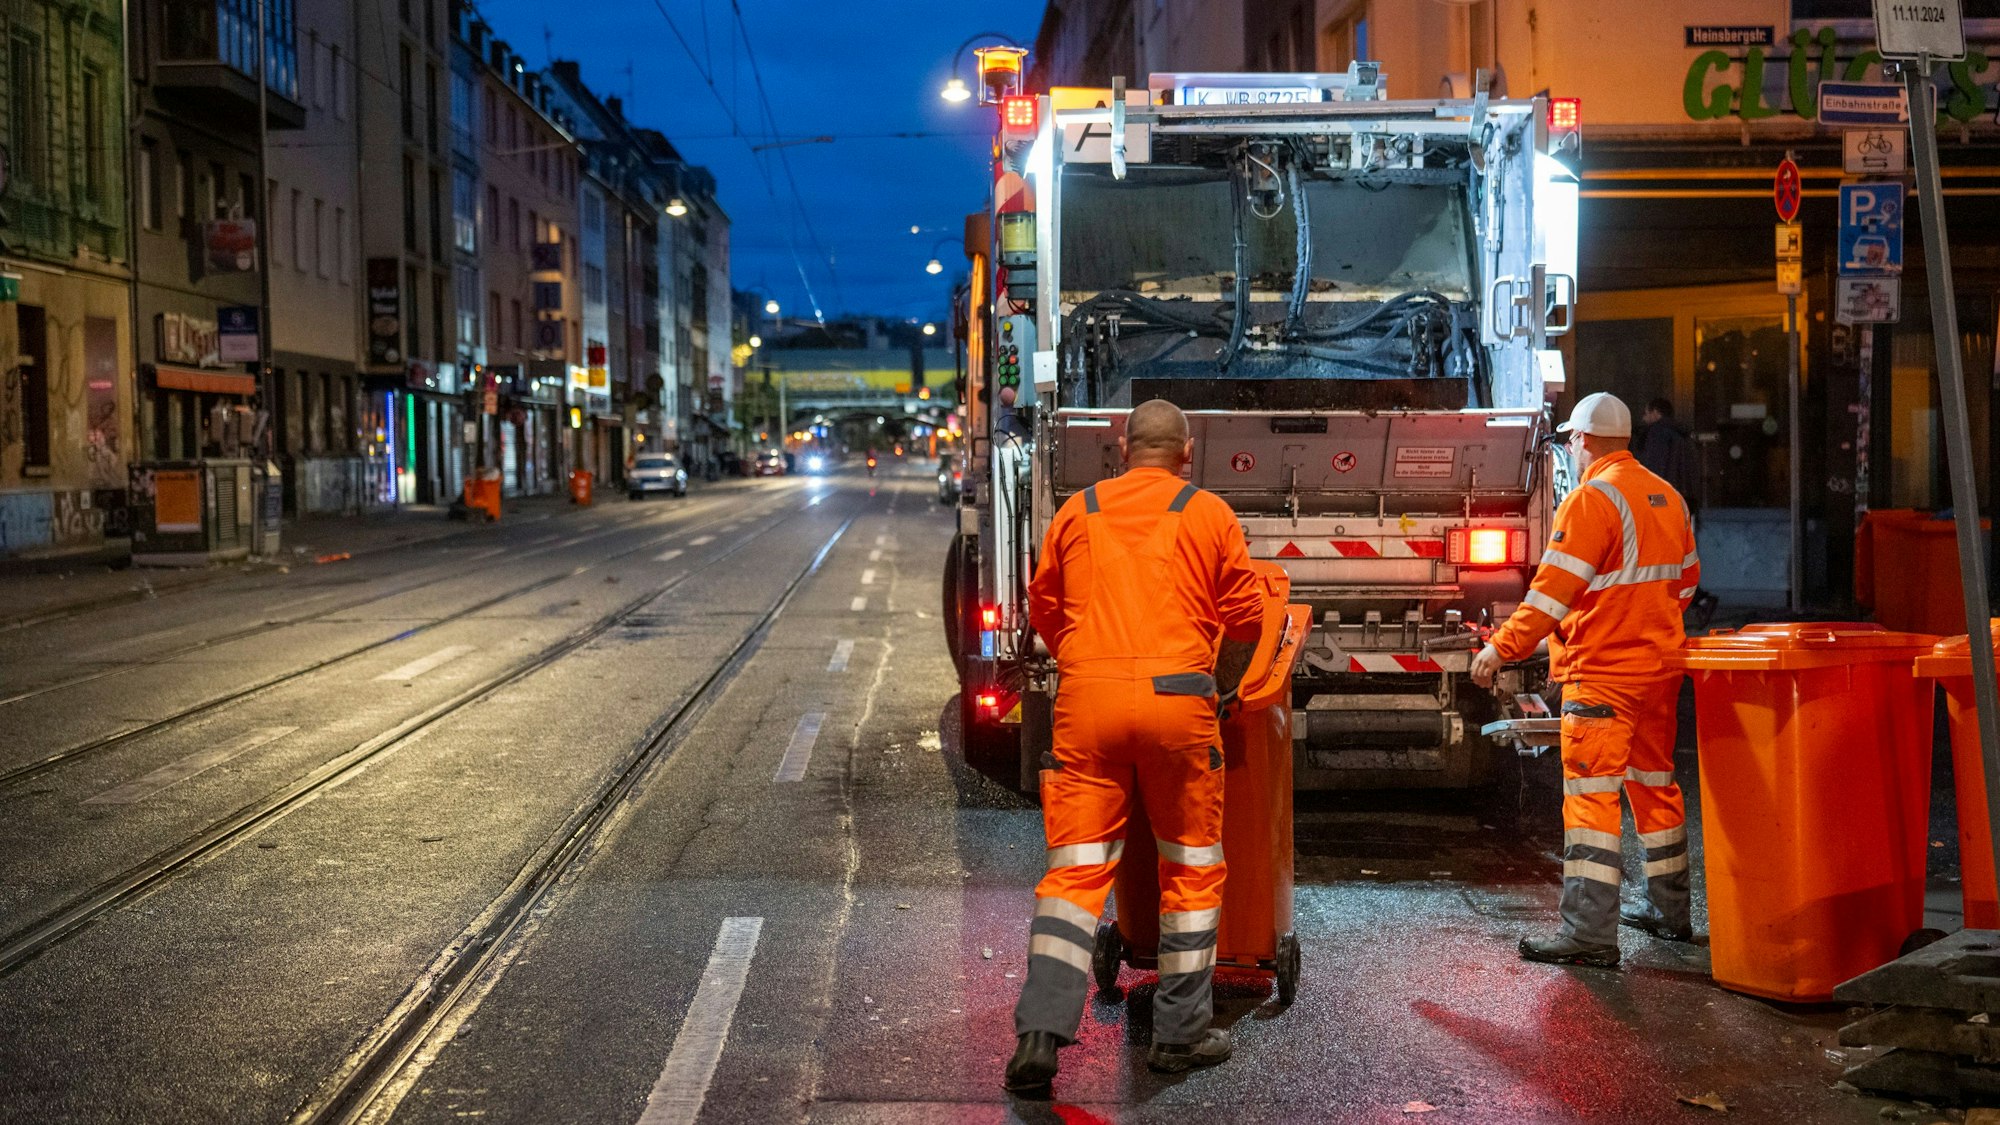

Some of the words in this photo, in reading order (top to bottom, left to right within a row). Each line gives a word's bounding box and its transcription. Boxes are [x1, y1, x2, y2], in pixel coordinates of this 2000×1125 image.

[1892, 4, 1945, 23] 11.11.2024
[1692, 27, 1767, 45] Heinsbergstr.
[1198, 91, 1210, 105] K
[1825, 98, 1901, 111] Einbahnstraße
[1074, 100, 1128, 152] A
[1850, 189, 1876, 226] P
